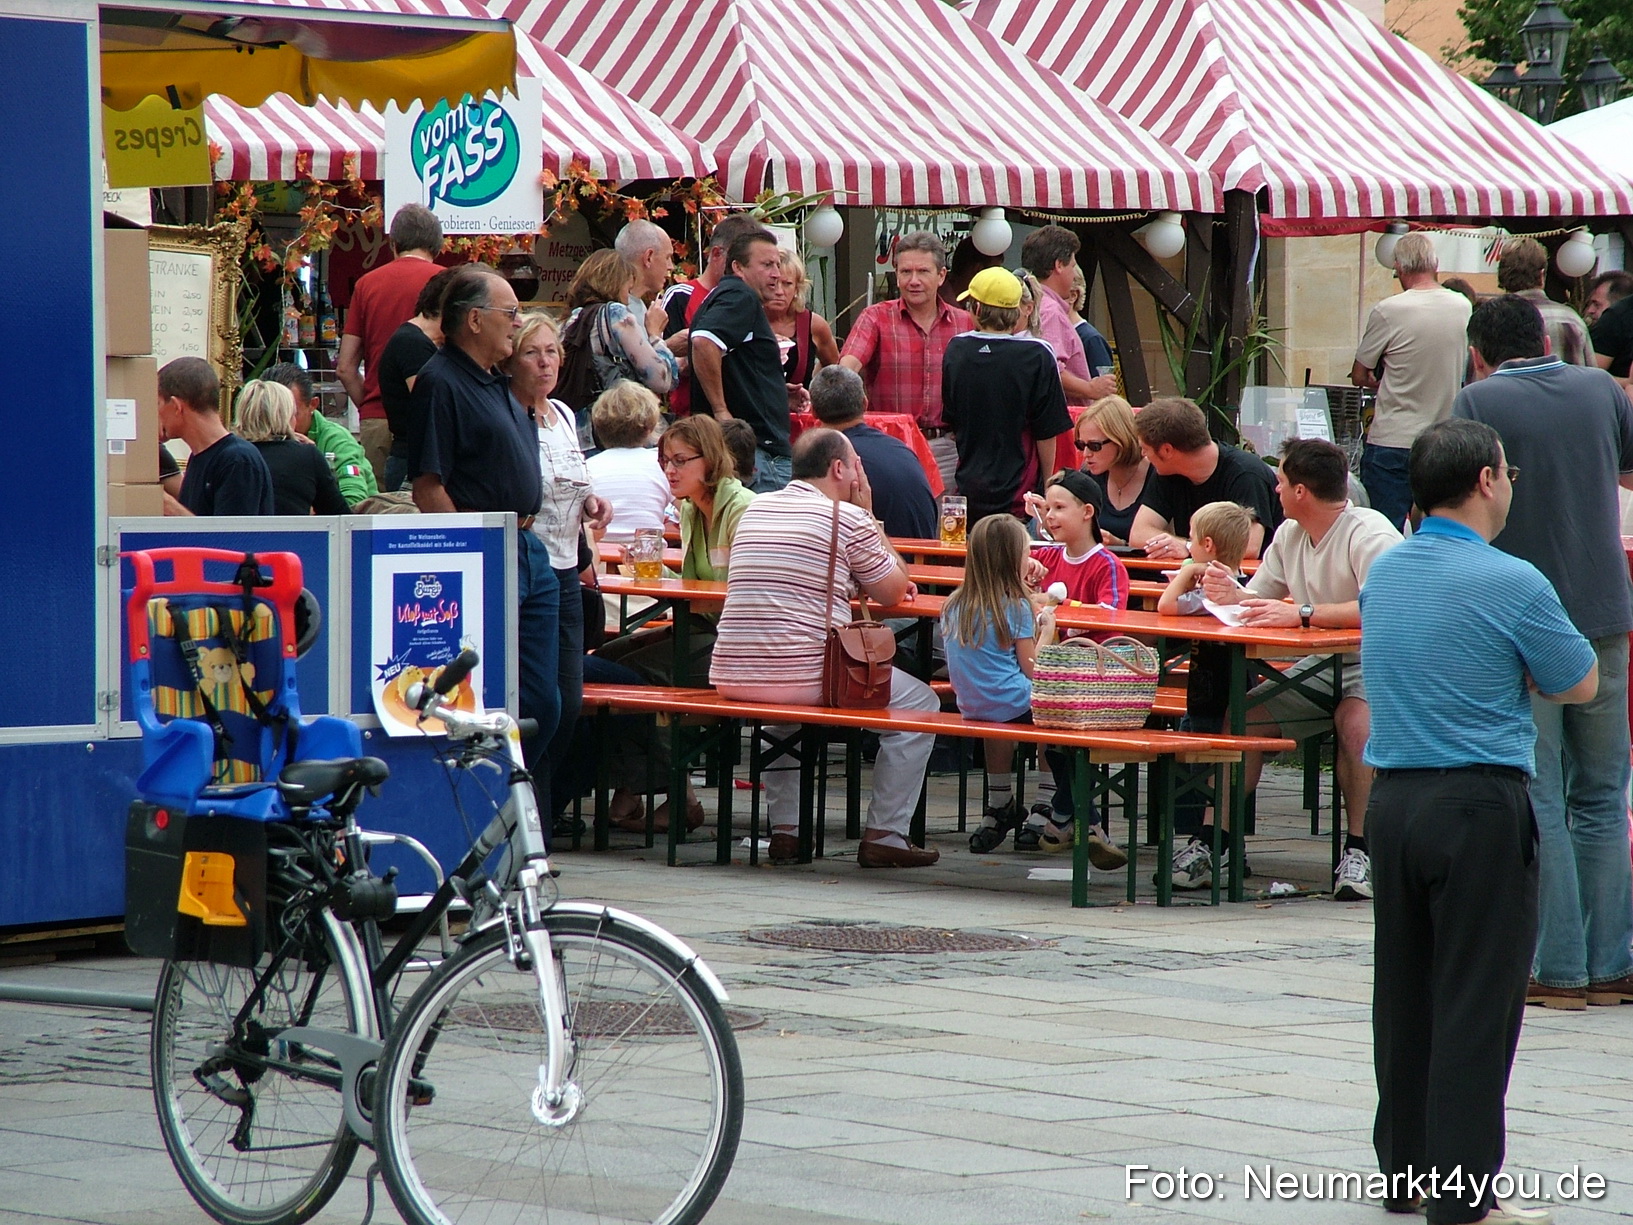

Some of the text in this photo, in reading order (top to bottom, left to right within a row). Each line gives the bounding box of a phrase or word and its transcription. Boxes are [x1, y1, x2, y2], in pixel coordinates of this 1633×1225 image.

[420, 102, 464, 155] vom
[422, 107, 504, 208] FASS
[102, 190, 122, 203] PECK
[439, 214, 537, 230] robieren Geniessen
[548, 241, 594, 259] Metzgere
[149, 259, 200, 277] TRANKE
[538, 265, 578, 287] Partyse
[151, 304, 172, 315] EIN
[384, 662, 401, 678] NEU
